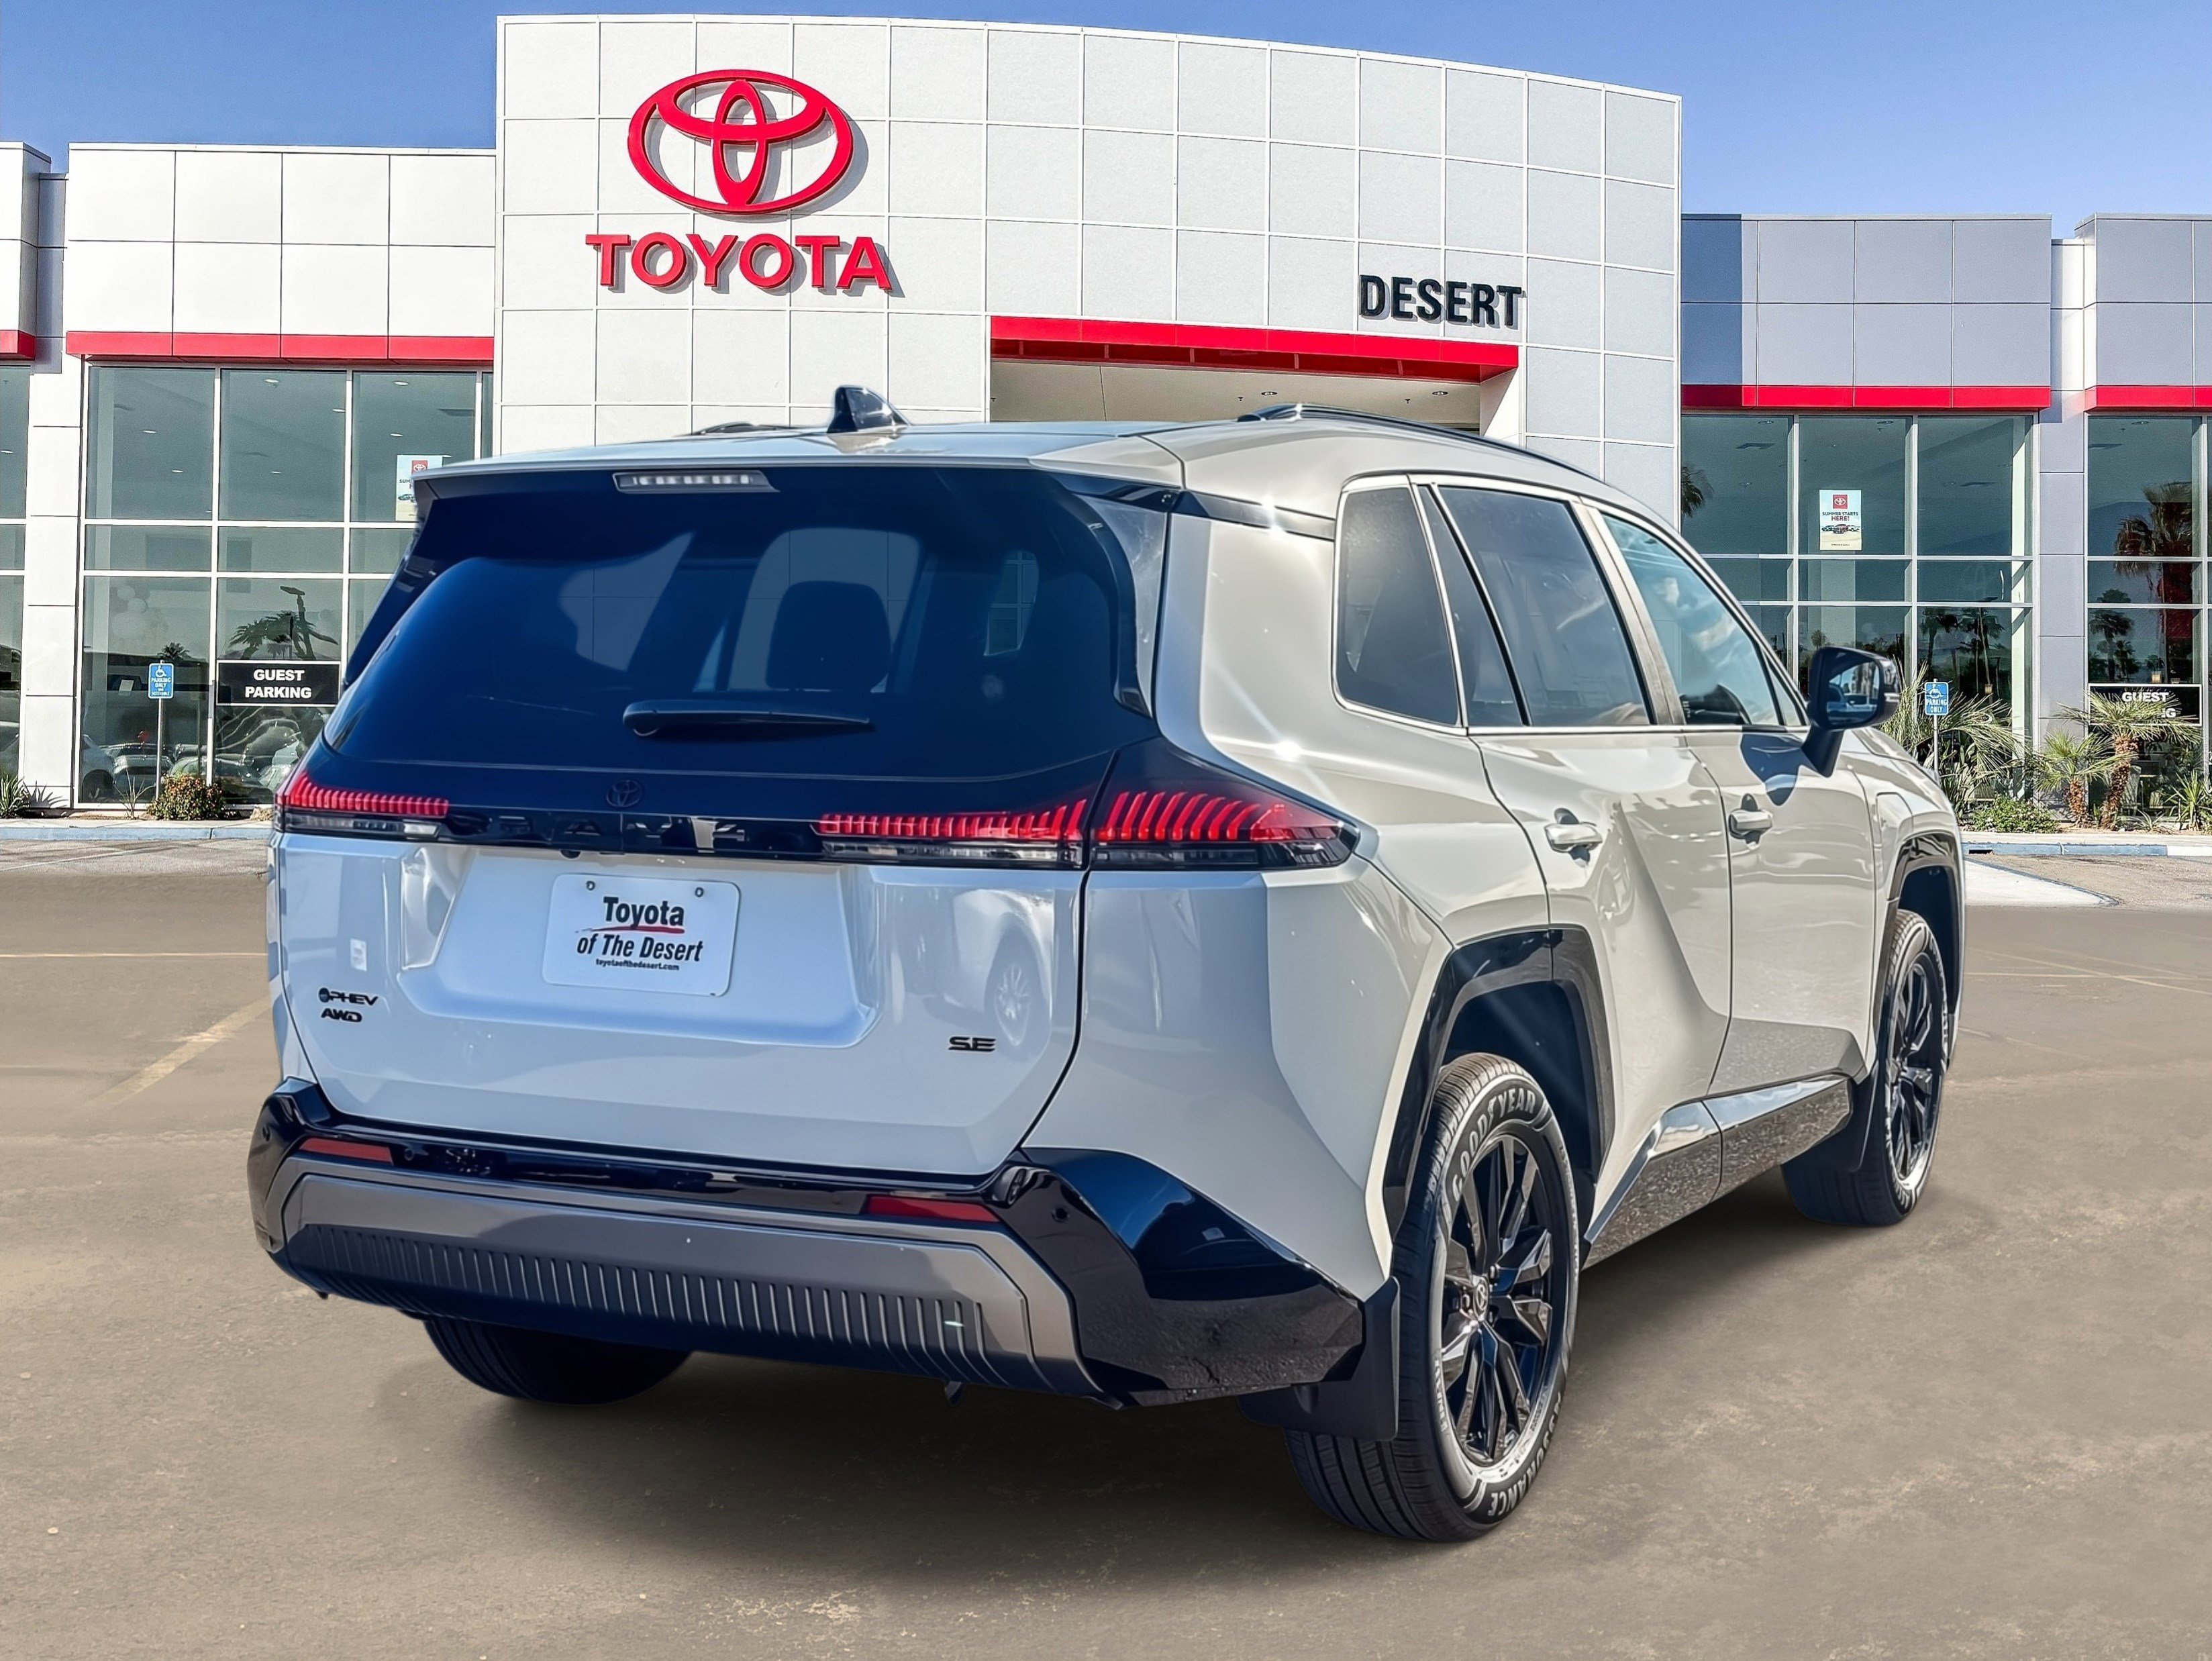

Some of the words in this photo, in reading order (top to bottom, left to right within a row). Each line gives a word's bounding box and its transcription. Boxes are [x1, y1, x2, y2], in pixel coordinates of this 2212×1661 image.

[585, 232, 892, 291] TOYOTA
[1359, 274, 1522, 327] DESERT
[253, 669, 305, 681] GUEST
[245, 686, 312, 699] PARKING
[2121, 691, 2170, 703] GUEST
[603, 896, 685, 929] Toyota
[577, 934, 599, 954] of
[602, 934, 635, 957] The
[640, 936, 704, 962] Desert
[321, 1008, 362, 1022] AWD
[948, 1036, 996, 1052] SE
